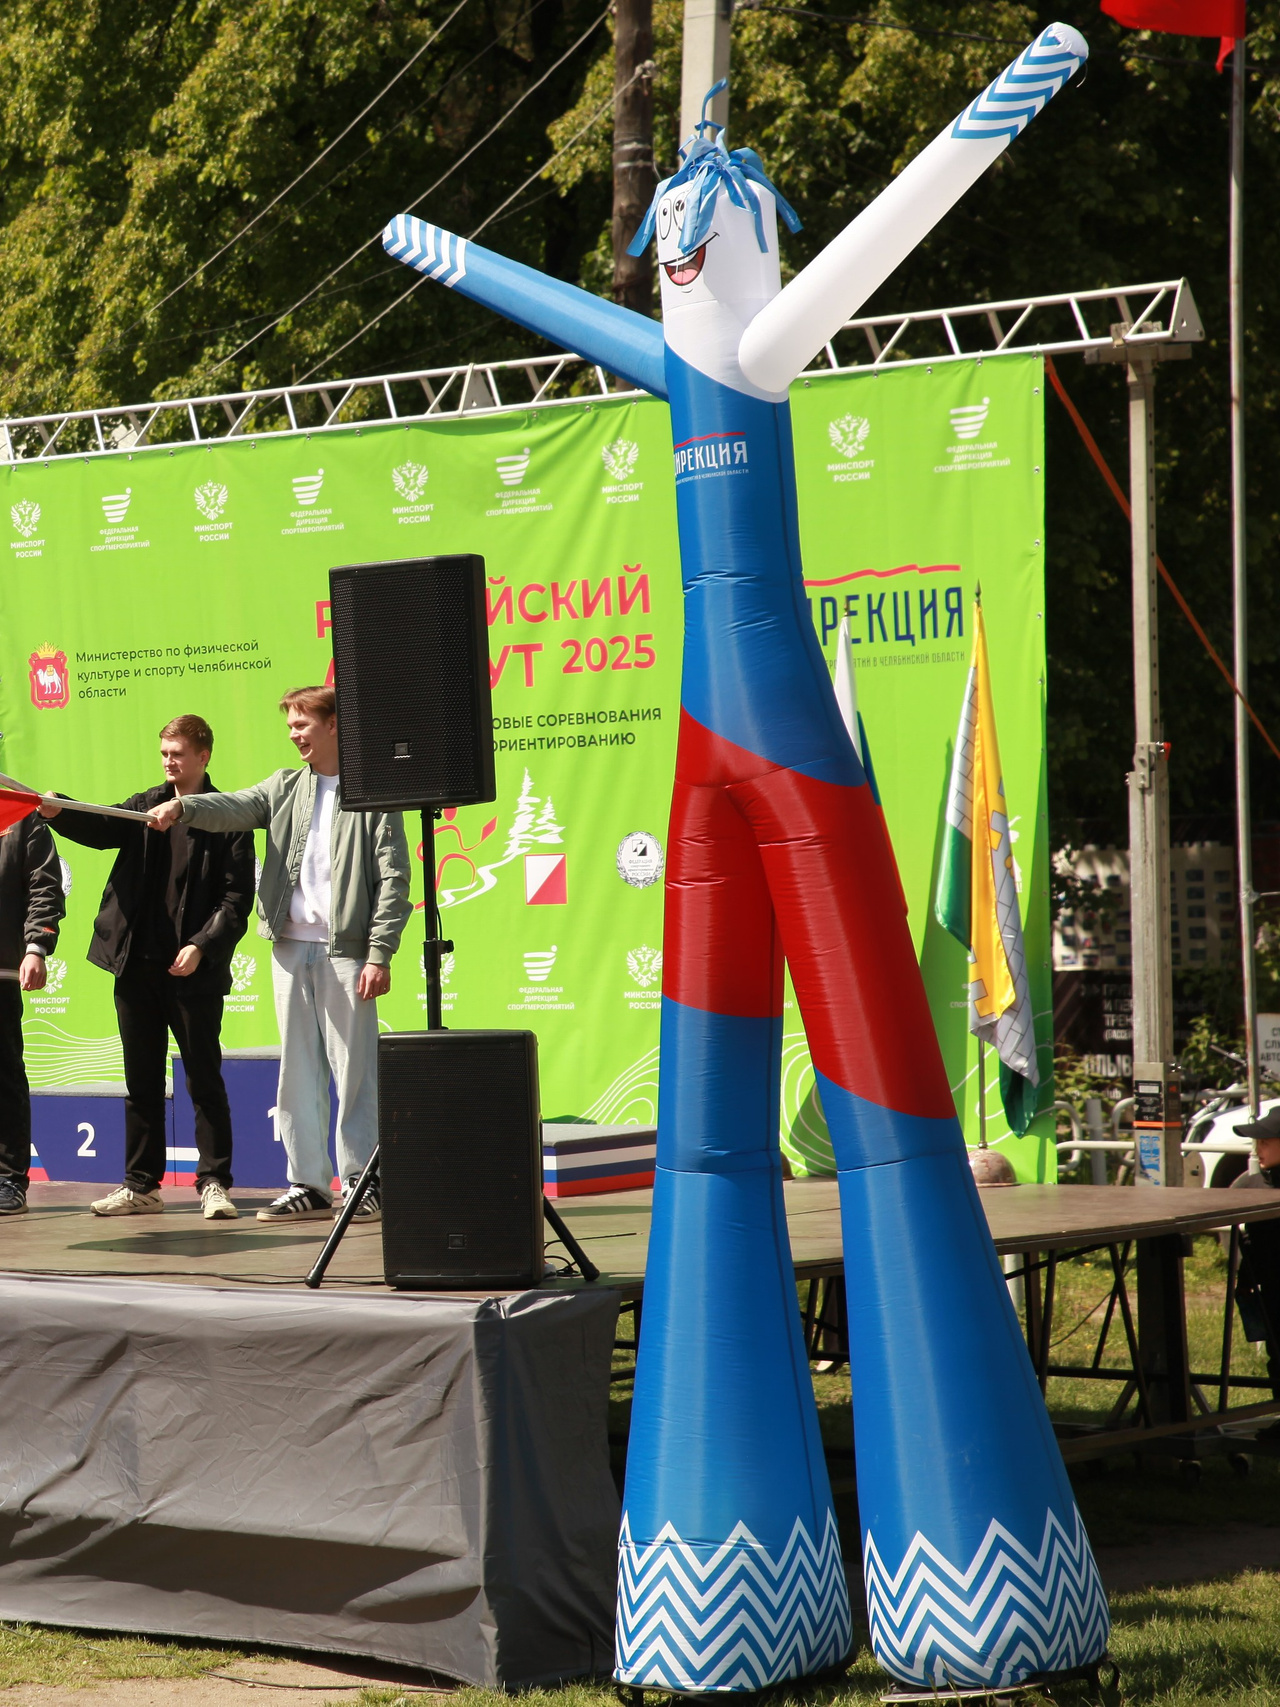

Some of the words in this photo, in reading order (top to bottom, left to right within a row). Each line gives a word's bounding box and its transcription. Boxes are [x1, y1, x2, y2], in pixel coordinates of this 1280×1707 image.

[945, 441, 998, 454] ФЕДЕРАЛЬНАЯ
[952, 452, 993, 463] ДИРЕКЦИЯ
[827, 459, 875, 472] МИНСПОРТ
[933, 458, 1011, 473] СПОРТМЕРОПРИЯТИЙ
[833, 472, 870, 482] РОССИИ
[495, 488, 541, 499] ФЕДЕРАЛЬНАЯ
[602, 482, 644, 494] МИНСПОРТ
[501, 497, 536, 507] ДИРЕКЦИЯ
[606, 494, 639, 505] РОССИИ
[290, 508, 332, 518] ФЕДЕРАЛЬНАЯ
[392, 503, 434, 515] МИНСПОРТ
[486, 503, 553, 517] СПОРТМЕРОПРИЯТИЙ
[295, 517, 328, 527] ДИРЕКЦИЯ
[398, 514, 431, 525] РОССИИ
[99, 526, 139, 536] ФЕДЕРАЛЬНАЯ
[194, 522, 233, 533] МИНСПОРТ
[281, 522, 345, 535] СПОРТМЕРОПРИЯТИЙ
[104, 534, 135, 544] ДИРЕКЦИЯ
[199, 533, 230, 542] РОССИИ
[10, 539, 45, 549] МИНСПОРТ
[90, 540, 150, 552] СПОРТМЕРОПРИЯТИЙ
[15, 550, 42, 558] РОССИИ
[76, 648, 163, 663] Министерство
[166, 646, 181, 658] по
[183, 639, 259, 658] физической
[560, 633, 656, 675] 2025
[879, 652, 929, 667] ЧЕЛЯБИНСКОЙ
[932, 651, 965, 663] ОБЛАСТИ
[77, 668, 130, 682] культуре
[133, 668, 141, 677] и
[144, 664, 186, 678] спорту
[188, 657, 272, 674] Челябинской
[78, 686, 127, 699] области
[537, 707, 662, 728] СОРЕВНОВАНИЯ
[493, 732, 636, 752] ОРИЕНТИРОВАНИЮ
[518, 986, 564, 994] ФЕДЕРАЛЬНАЯ
[624, 991, 662, 999] МИНСПОР
[30, 997, 70, 1005] МИНСПОРТ
[524, 995, 559, 1003] ДИРЕКЦИЯ
[507, 1002, 575, 1010] СПОРТМЕРОПРИЯТИЙ
[629, 1002, 662, 1010] РОССИИ
[267, 1106, 281, 1142] 1
[77, 1121, 97, 1157] 2
